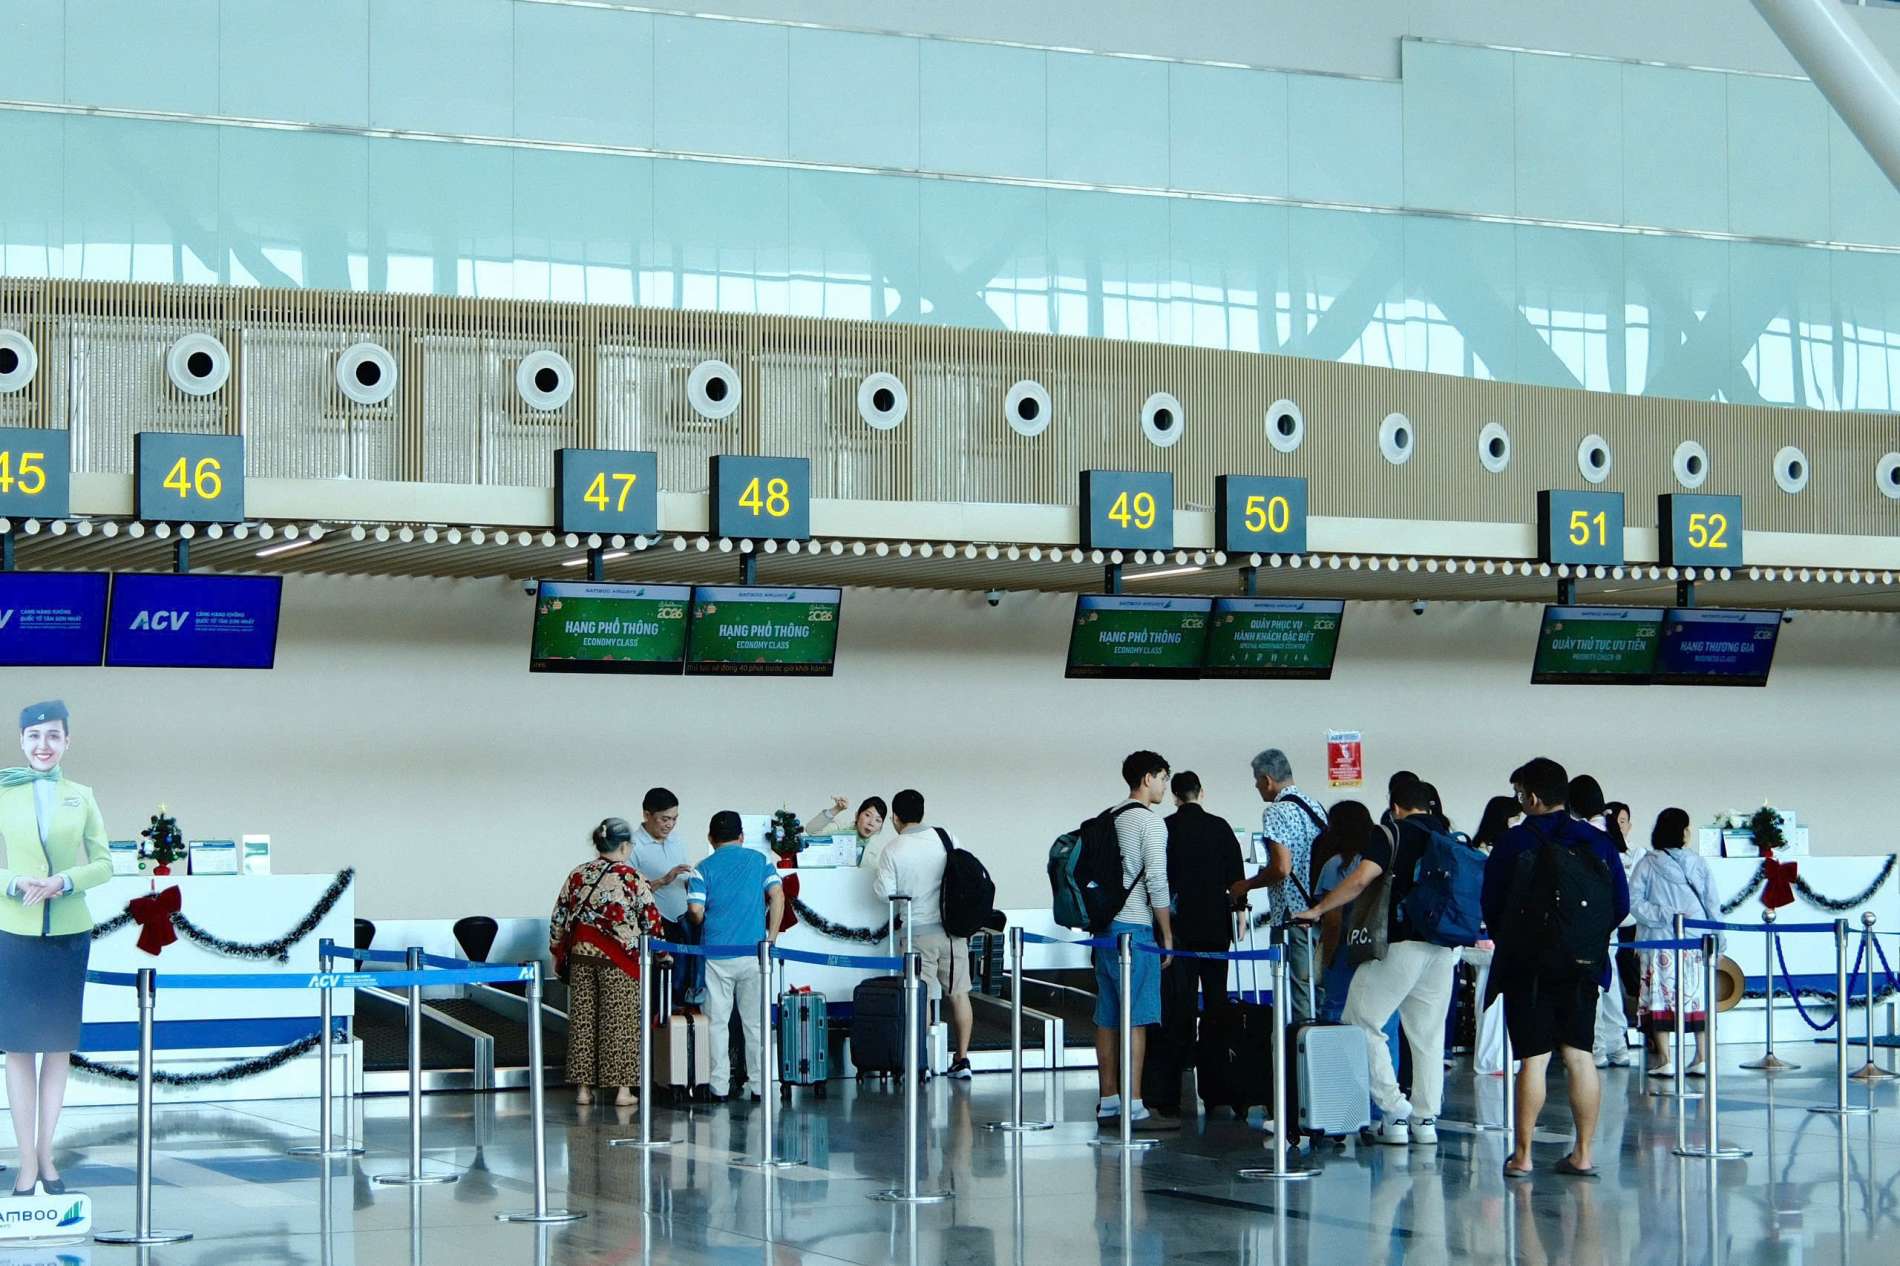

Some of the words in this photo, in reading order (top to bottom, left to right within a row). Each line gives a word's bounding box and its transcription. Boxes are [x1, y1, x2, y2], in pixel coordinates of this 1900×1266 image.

[0, 451, 46, 494] 45
[163, 457, 222, 499] 46
[583, 472, 637, 512] 47
[738, 478, 790, 517] 48
[1108, 491, 1156, 529] 49
[1245, 496, 1289, 533] 50
[1569, 510, 1606, 546] 51
[1688, 513, 1728, 548] 52
[129, 610, 190, 631] ACV
[657, 608, 684, 619] 2026
[808, 611, 833, 621] 2026
[565, 620, 595, 636] HẠNG
[598, 617, 620, 634] PHỔ
[623, 619, 659, 635] THÔNG
[719, 624, 749, 640] HẠNG
[751, 620, 771, 637] PHỔ
[775, 622, 809, 637] THÔNG
[1099, 632, 1126, 645] HẠNG
[1127, 628, 1147, 643] PHỔ
[1149, 630, 1182, 643] THÔNG
[583, 637, 616, 647] ECONOMY
[616, 637, 639, 647] CLASS
[736, 640, 768, 649] ECONOMY
[768, 641, 790, 649] CLASS
[1114, 646, 1143, 654] ECONOMY
[1143, 646, 1163, 654] CLASS
[1680, 641, 1704, 655] HẠNG
[1740, 643, 1755, 653] GIA
[308, 975, 340, 988] ACV
